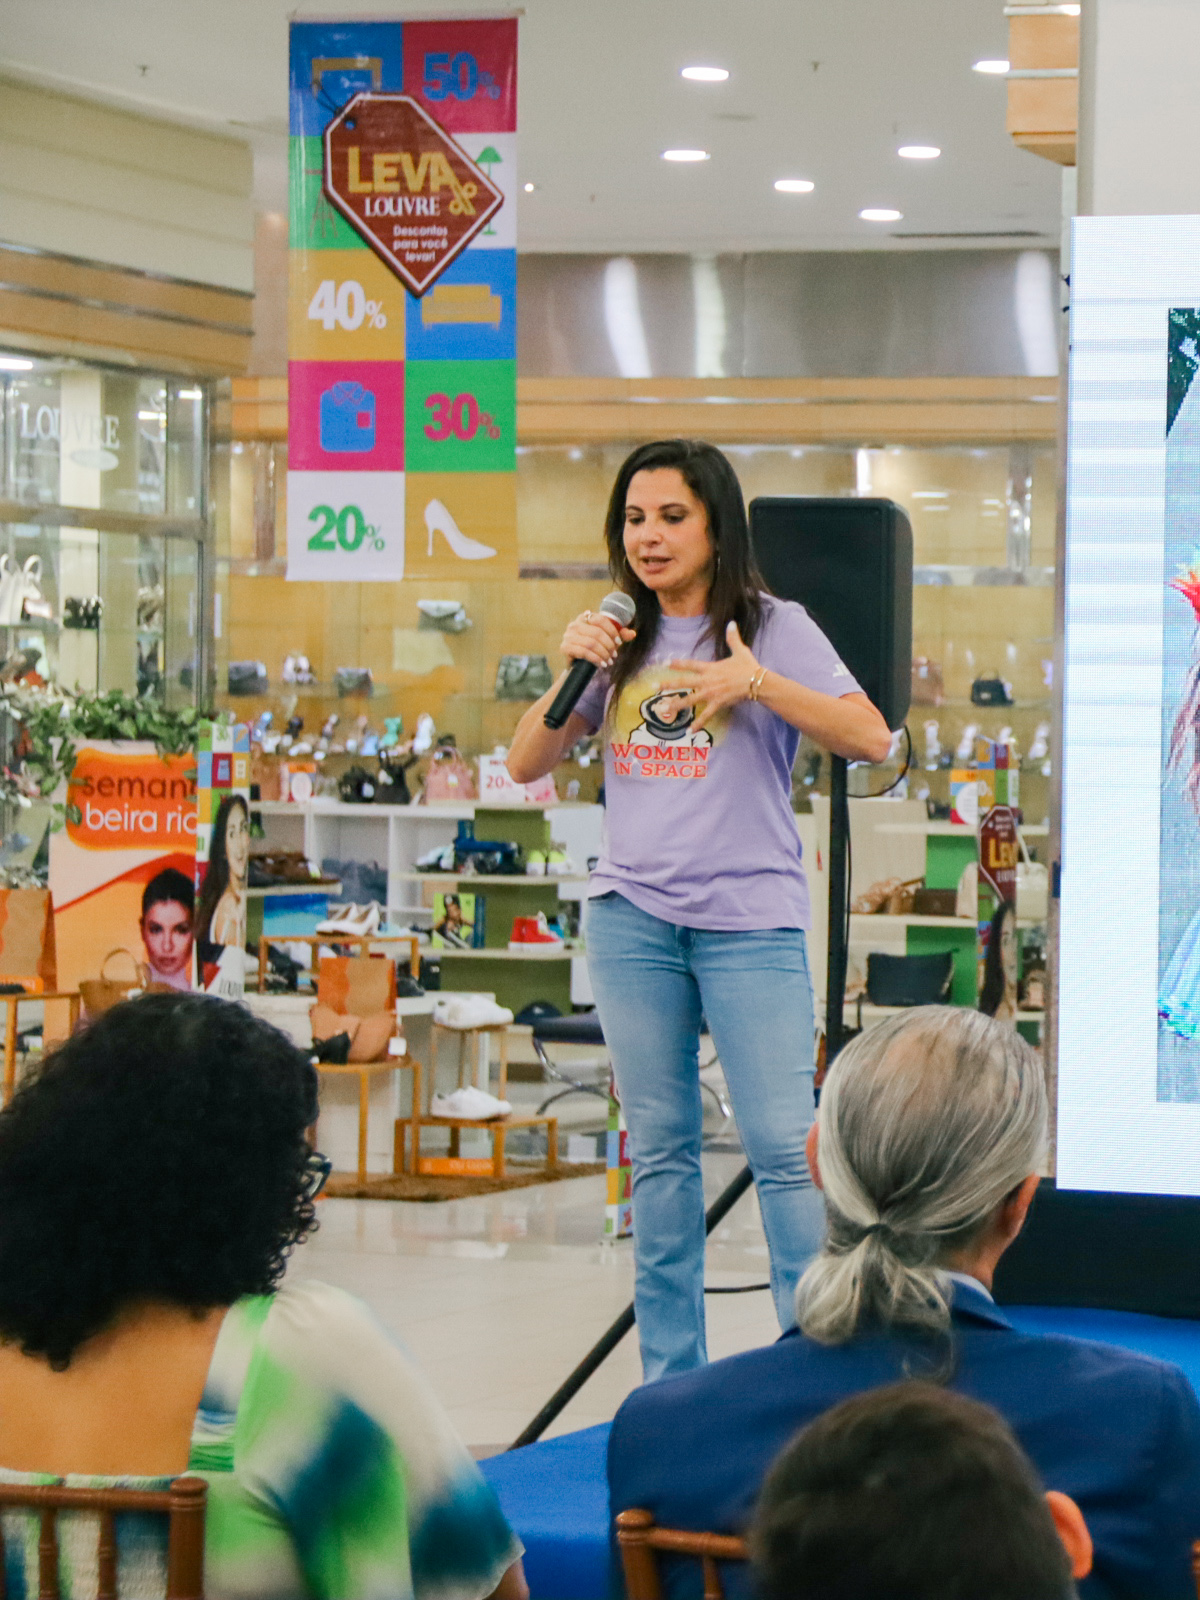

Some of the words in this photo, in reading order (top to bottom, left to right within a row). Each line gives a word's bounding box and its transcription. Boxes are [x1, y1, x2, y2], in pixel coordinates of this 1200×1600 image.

[423, 51, 501, 101] 50%
[348, 146, 464, 194] LEVA
[365, 196, 440, 217] LOUVRE
[393, 224, 448, 236] Descontos
[393, 239, 419, 251] para
[420, 236, 448, 249] você
[307, 280, 387, 330] 40%
[423, 392, 501, 441] 30%
[307, 504, 385, 552] 20%
[611, 742, 709, 762] WOMEN
[614, 761, 632, 776] IN
[641, 762, 707, 778] SPACE
[86, 801, 158, 833] beira
